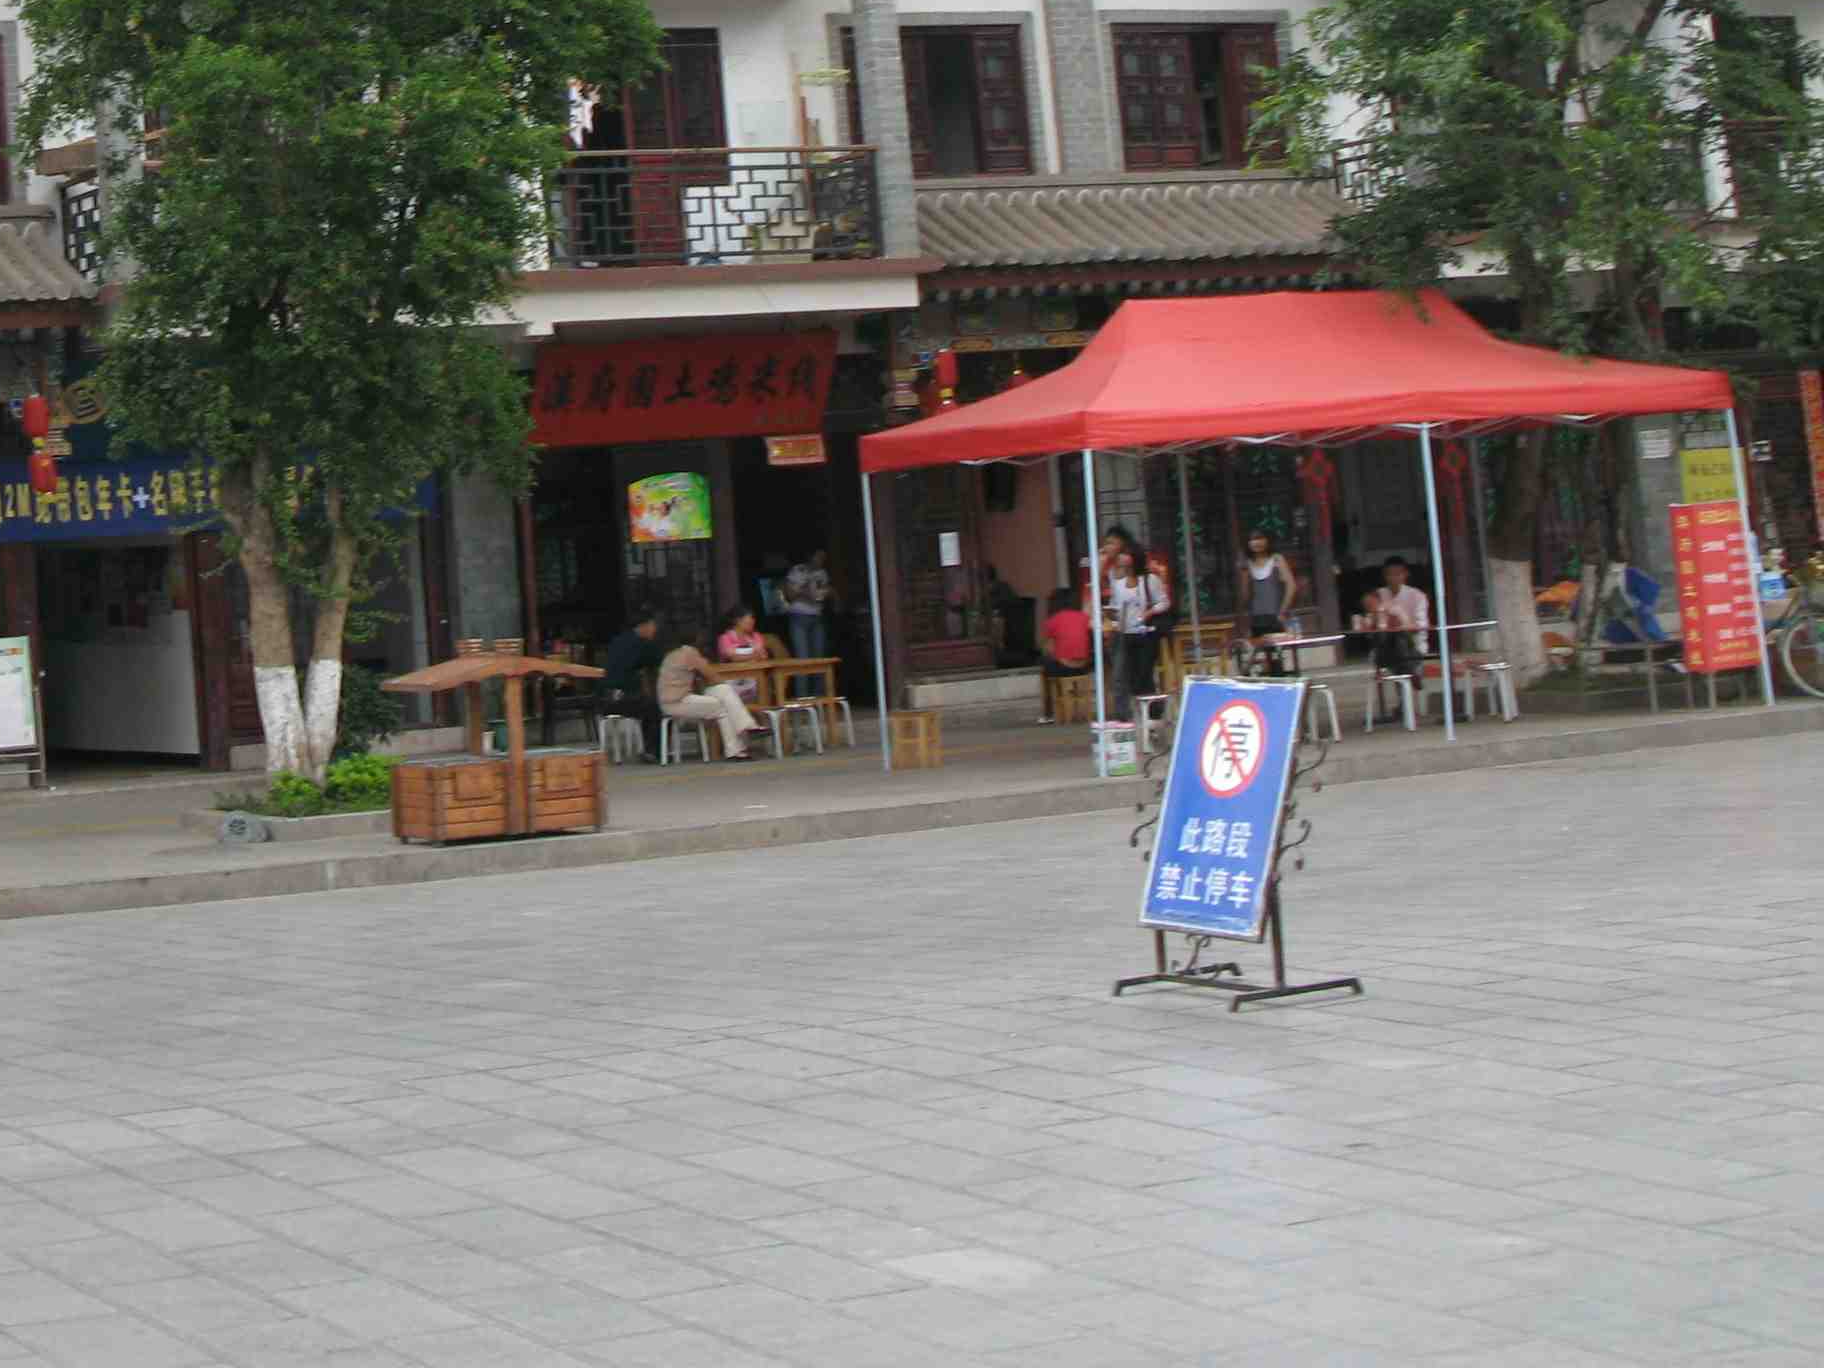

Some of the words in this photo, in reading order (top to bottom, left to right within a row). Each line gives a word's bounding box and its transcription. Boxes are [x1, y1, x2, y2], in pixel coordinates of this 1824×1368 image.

[1210, 718, 1255, 779] 停
[1178, 818, 1254, 860] 此路段
[1155, 862, 1255, 910] 禁止停车
